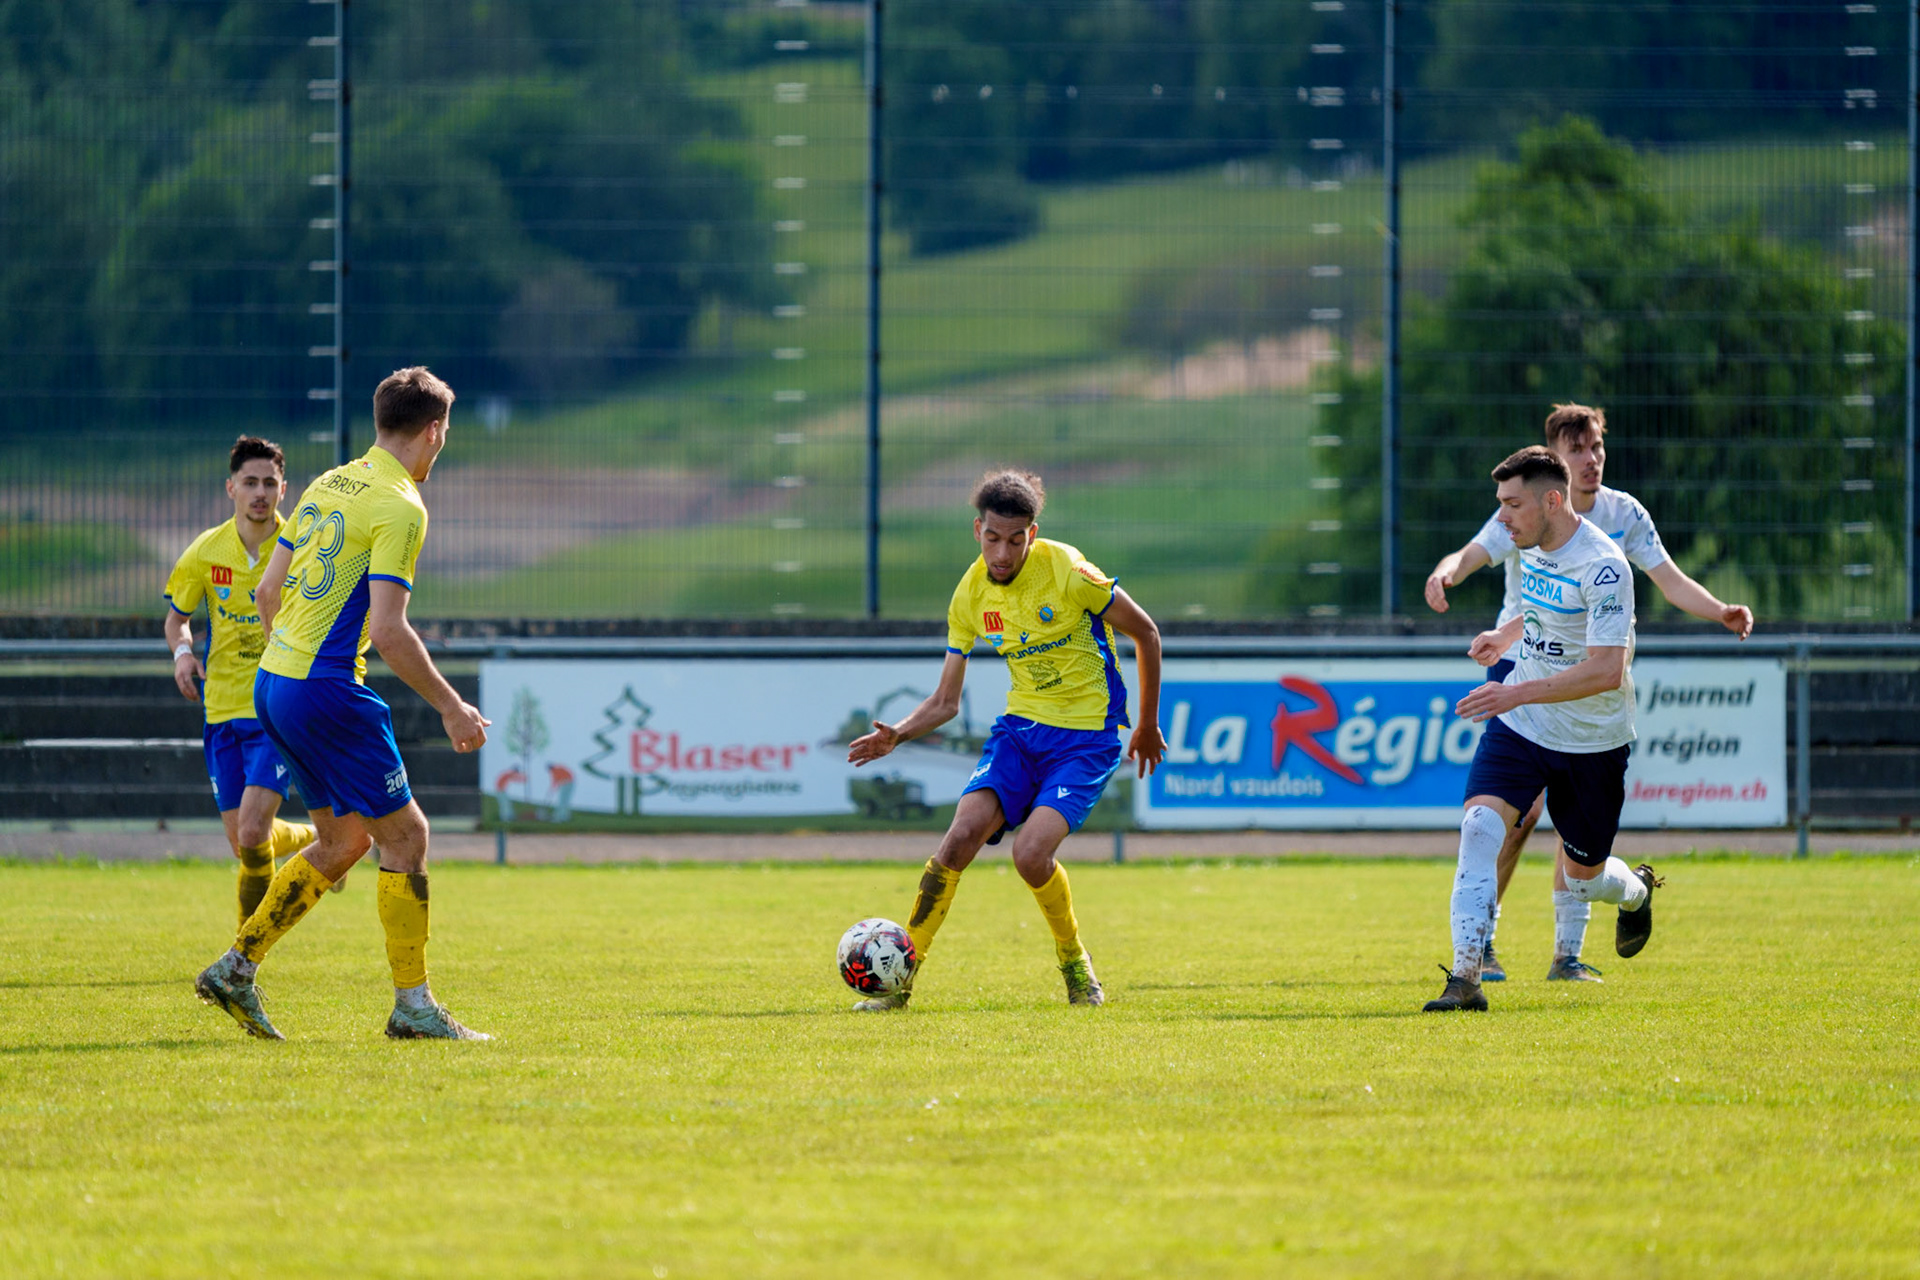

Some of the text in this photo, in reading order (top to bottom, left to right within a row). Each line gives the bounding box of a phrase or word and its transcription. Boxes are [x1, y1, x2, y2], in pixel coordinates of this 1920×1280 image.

[295, 502, 345, 600] 23
[1647, 678, 1756, 714] journal
[1165, 675, 1488, 785] La Régio
[1647, 728, 1743, 764] région
[630, 730, 808, 774] Blaser
[1165, 771, 1324, 797] Nord vaudois
[1626, 777, 1768, 809] .laregion.ch
